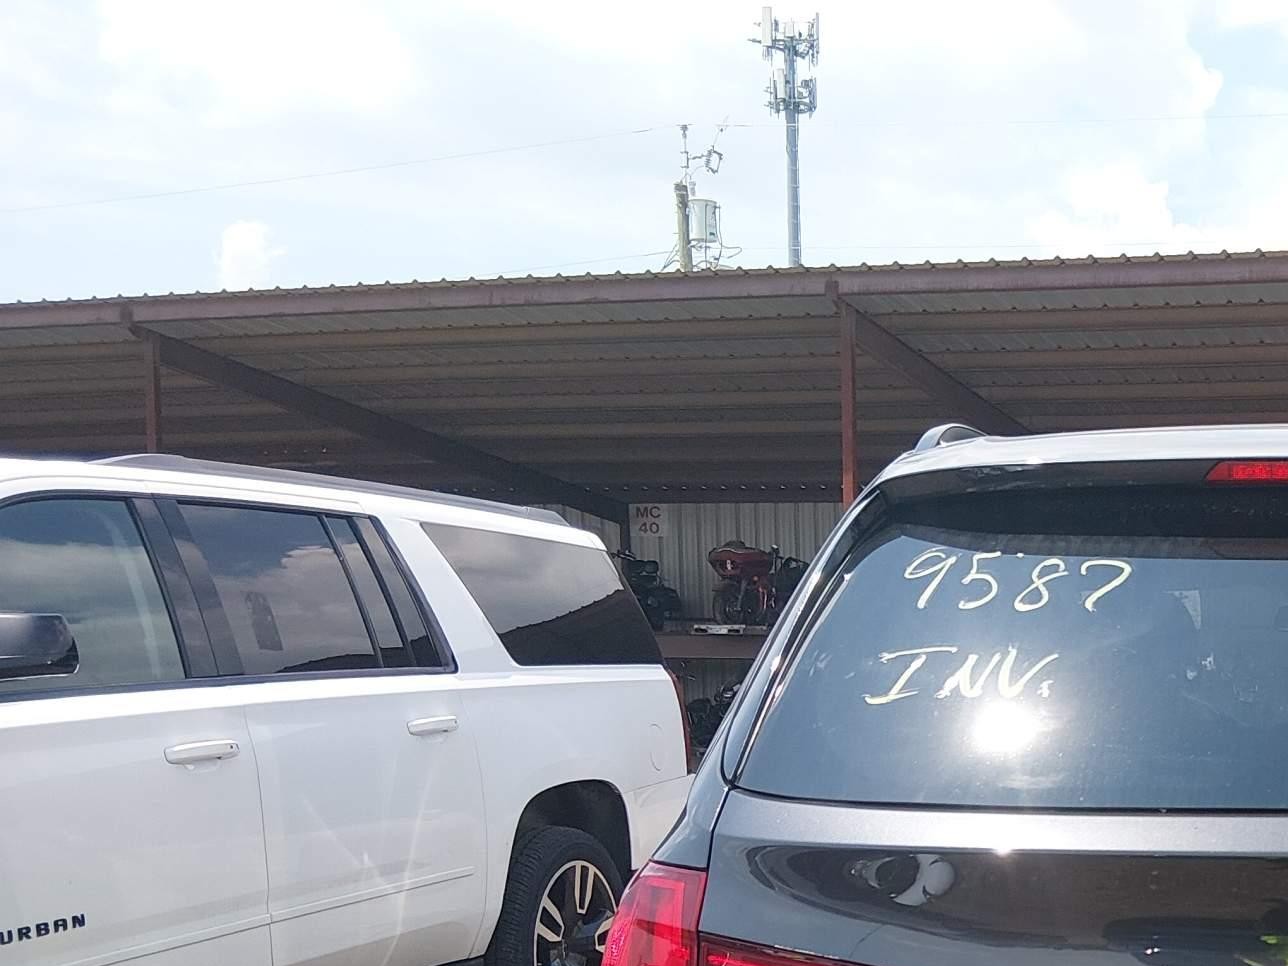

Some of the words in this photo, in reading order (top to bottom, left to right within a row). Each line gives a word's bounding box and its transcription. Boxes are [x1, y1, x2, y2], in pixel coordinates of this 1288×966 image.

[635, 505, 661, 519] MC
[639, 521, 660, 534] 40
[903, 546, 1132, 612] 9587
[0, 913, 86, 946] URBAN
